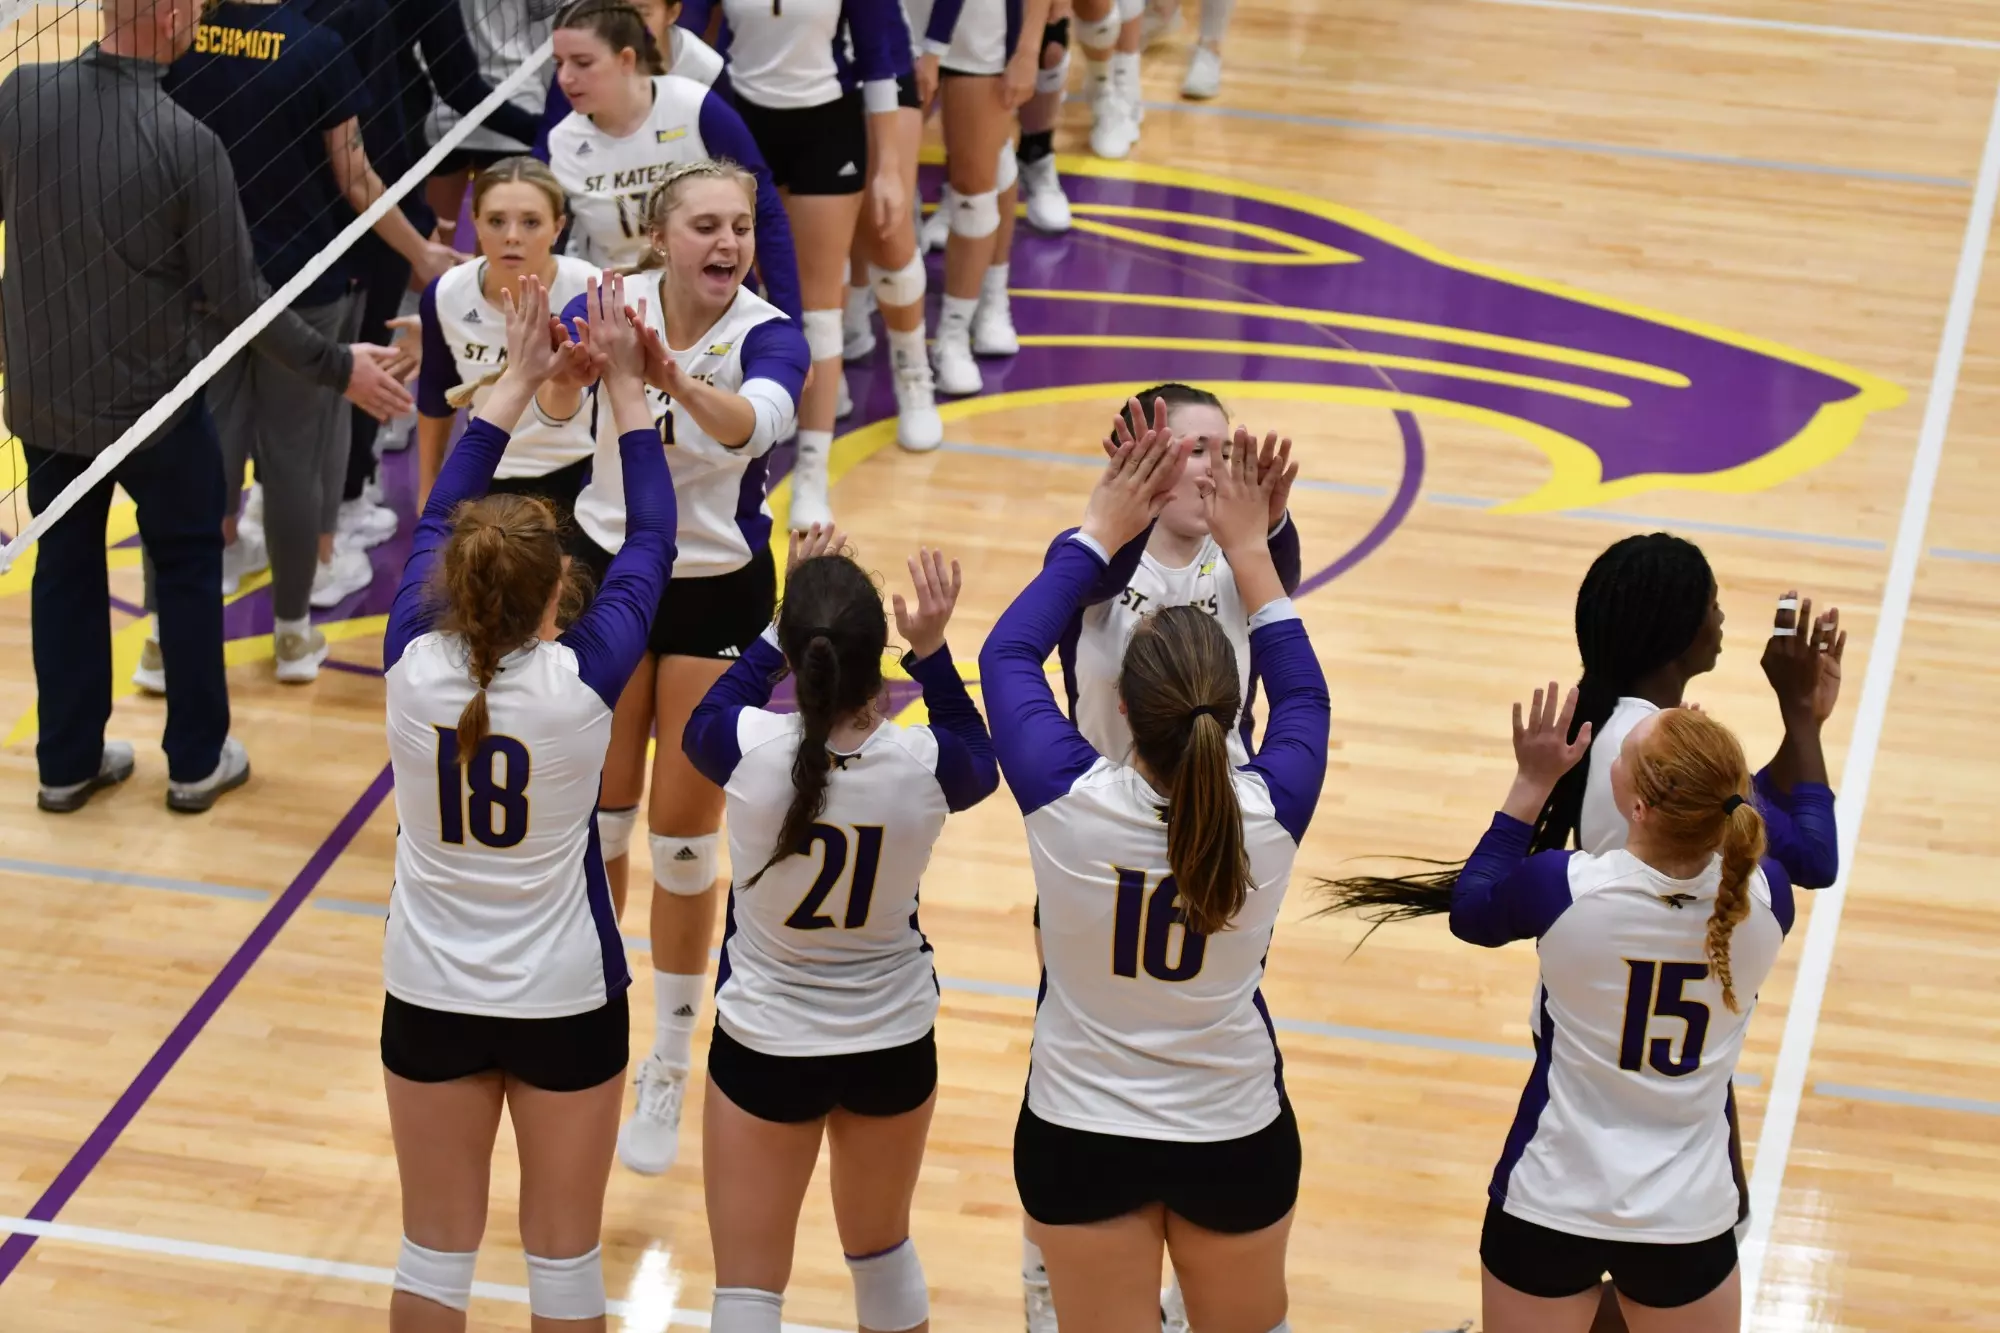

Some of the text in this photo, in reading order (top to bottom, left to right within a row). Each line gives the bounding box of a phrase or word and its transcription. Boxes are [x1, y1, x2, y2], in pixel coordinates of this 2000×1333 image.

[195, 24, 286, 61] SCHMIDT
[584, 174, 607, 192] ST.
[464, 343, 489, 363] ST.
[1120, 586, 1149, 615] ST.
[431, 723, 532, 849] 18
[782, 822, 886, 931] 21
[1110, 864, 1209, 982] 16
[1618, 957, 1713, 1078] 15
